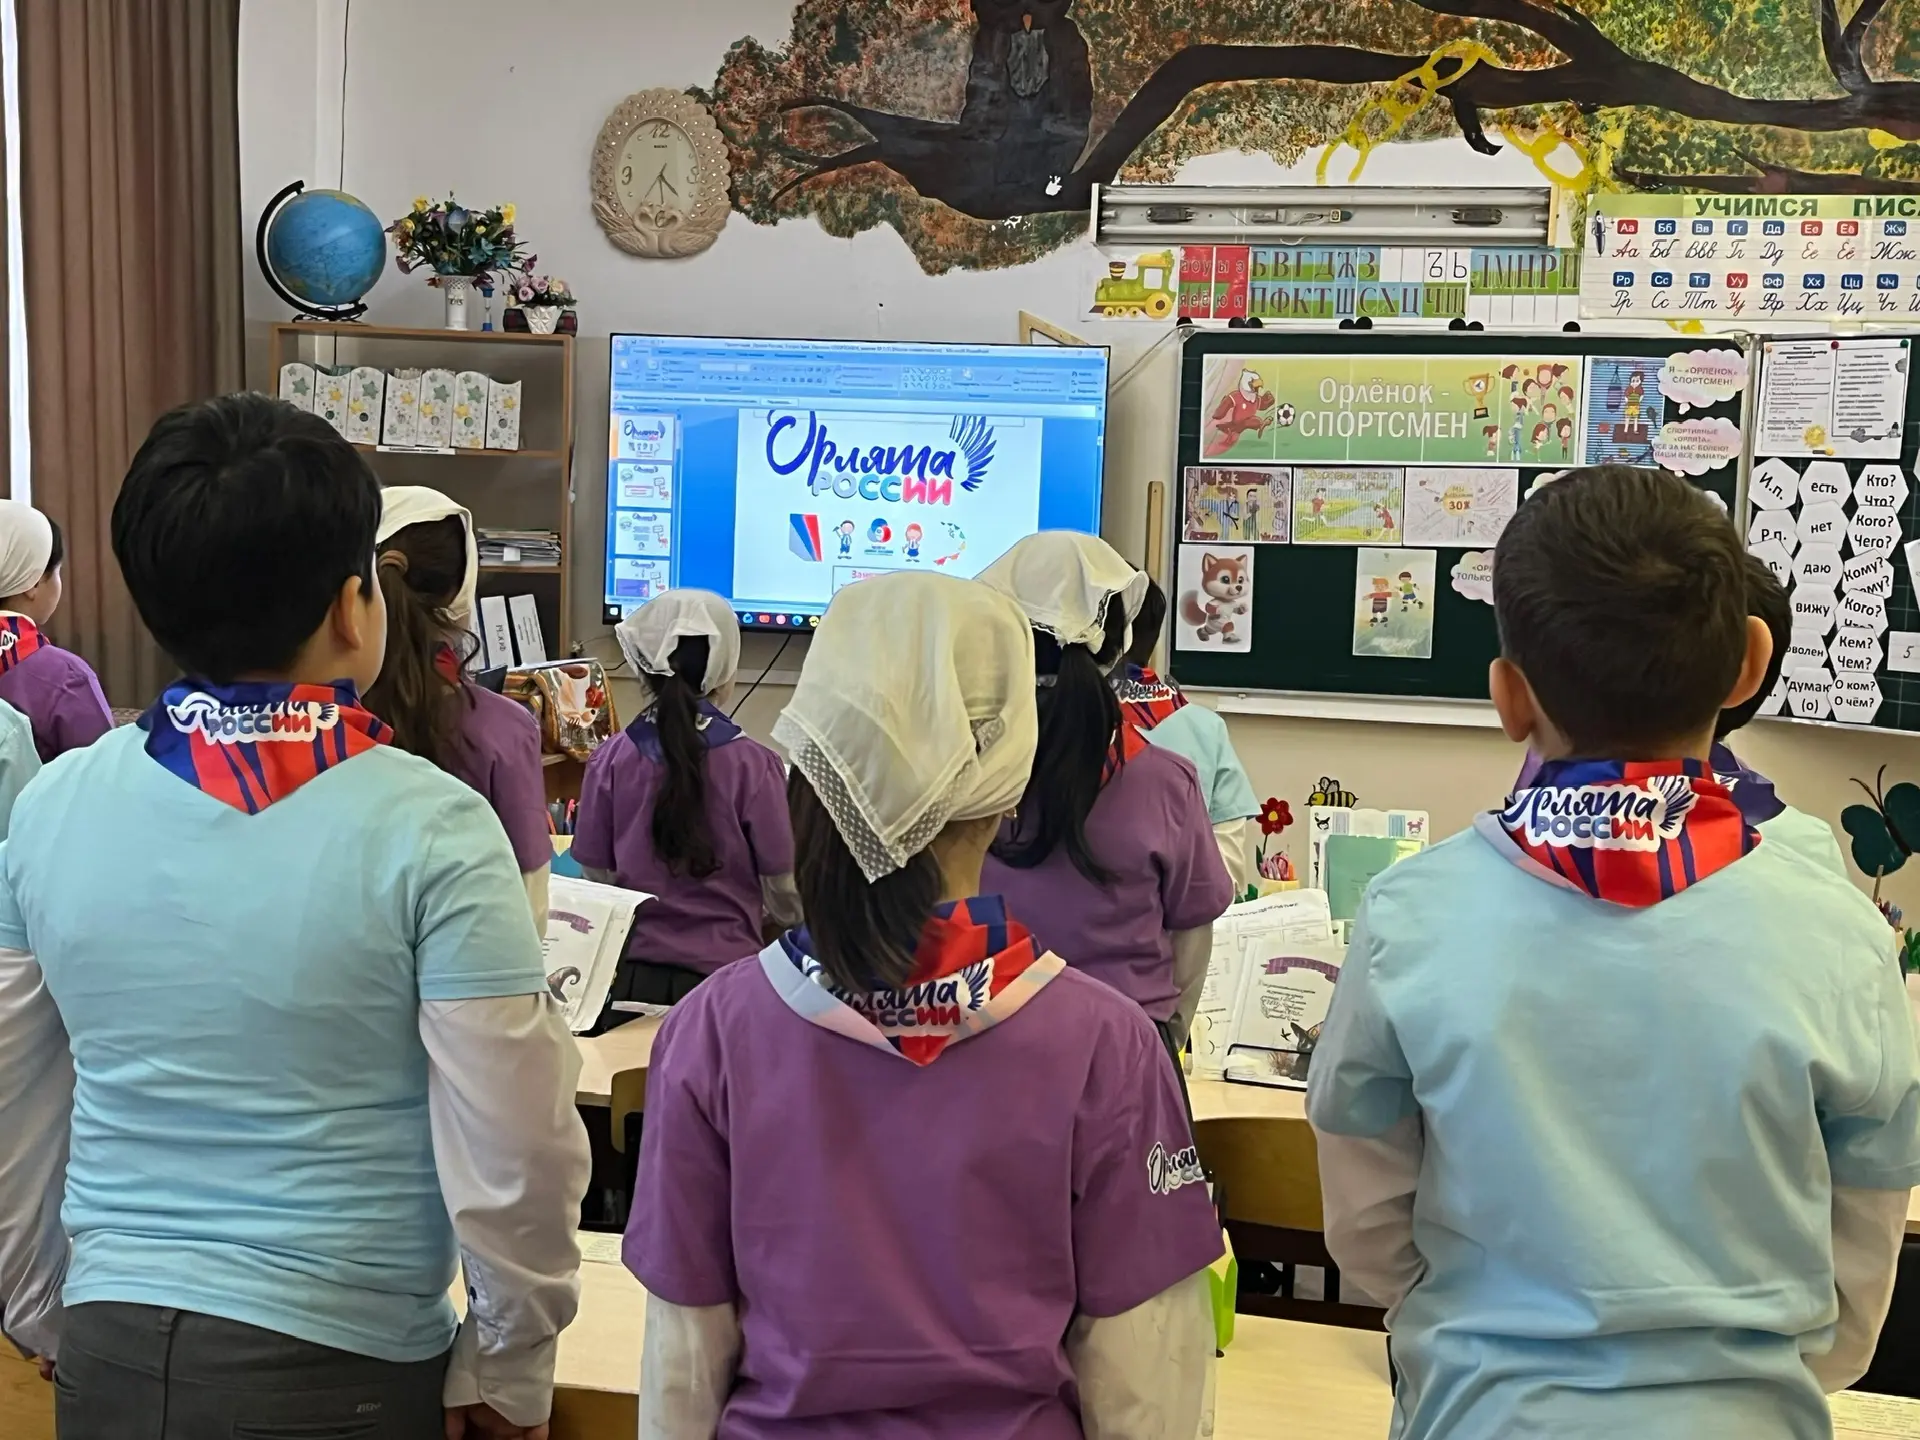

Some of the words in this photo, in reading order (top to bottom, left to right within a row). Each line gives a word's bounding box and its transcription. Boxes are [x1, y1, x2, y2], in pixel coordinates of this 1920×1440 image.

[649, 124, 671, 138] 12
[1695, 198, 1818, 217] УЧИМСЯ
[1853, 198, 1920, 217] ПИС
[1620, 224, 1635, 233] Аа
[1658, 223, 1673, 233] Бб
[1696, 223, 1709, 233] Вв
[1732, 224, 1743, 233] Гг
[1765, 223, 1781, 235] Дд
[1885, 224, 1905, 234] Жж
[1612, 240, 1640, 258] Аа
[1649, 239, 1680, 259] Бб
[1759, 241, 1785, 267] Дд
[1617, 275, 1631, 287] Рр
[1654, 275, 1669, 285] Сс
[1693, 276, 1708, 286] Тт
[1730, 276, 1744, 289] Уу
[1763, 276, 1783, 289] Фф
[1806, 277, 1821, 287] Хх
[1844, 277, 1860, 289] Цц
[1880, 277, 1895, 287] Чч
[1610, 289, 1633, 316] Рр
[1651, 291, 1669, 309] Сс
[1725, 292, 1745, 317] Уу
[1795, 292, 1829, 311] Хх
[1837, 293, 1865, 315] Цц
[1878, 293, 1898, 312] Чч
[1319, 377, 1433, 408] Орлёнок
[1299, 411, 1467, 438] СПОРТСМЕН
[766, 410, 956, 486] Орлята
[1759, 472, 1784, 500] И.п.
[1811, 482, 1838, 493] есть
[1866, 474, 1897, 487] Кто?
[812, 471, 952, 506] РОССИИ
[1810, 521, 1833, 534] нет
[1856, 514, 1894, 527] Кого?
[1854, 535, 1891, 549] Чего?
[1803, 564, 1831, 574] даю
[1844, 557, 1884, 581] Кому?
[1456, 572, 1492, 582] ТОЛЬКО
[1796, 603, 1830, 617] вижу
[1845, 597, 1882, 618] Кого?
[1839, 636, 1873, 649] Кем?
[1903, 645, 1914, 659] 5
[1837, 656, 1872, 670] Чем?
[1835, 679, 1844, 689] О
[1846, 680, 1875, 691] ком?
[1802, 698, 1818, 714] (о)
[1834, 695, 1843, 706] О
[1846, 696, 1875, 708] чём?
[208, 713, 311, 738] РОССИИ
[1535, 815, 1655, 840] РОССИИ
